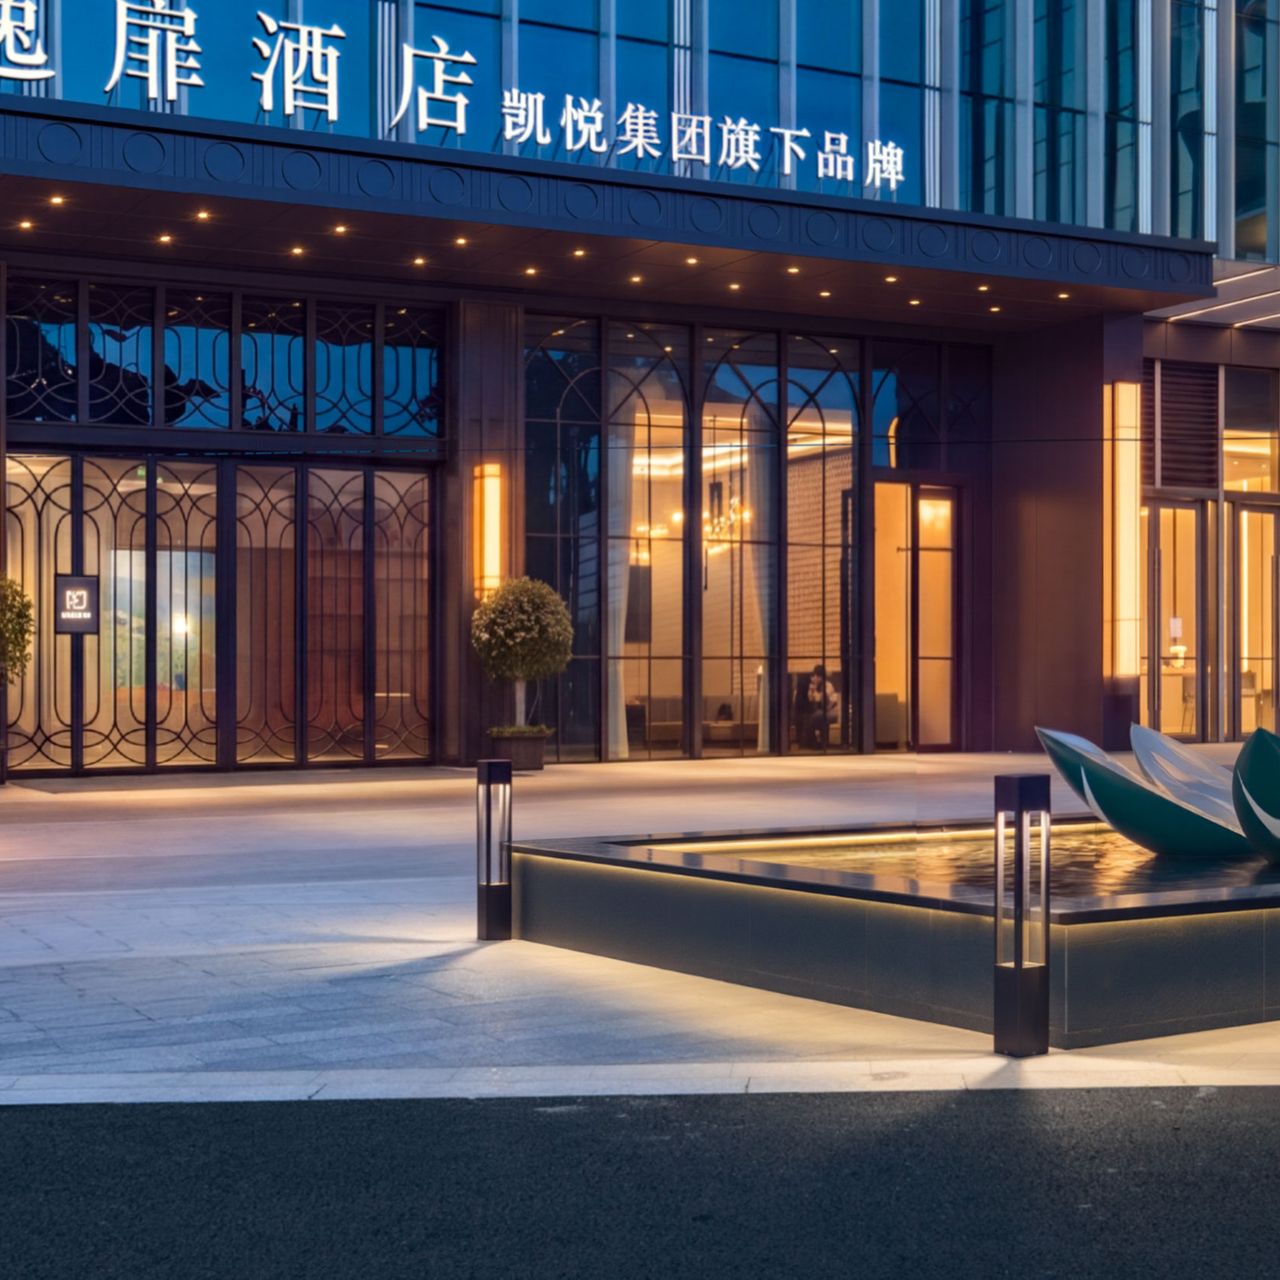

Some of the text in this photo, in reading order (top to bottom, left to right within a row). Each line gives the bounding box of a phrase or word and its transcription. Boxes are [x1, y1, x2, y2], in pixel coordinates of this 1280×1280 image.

[500, 86, 907, 191] 凯悦集团旗下品牌
